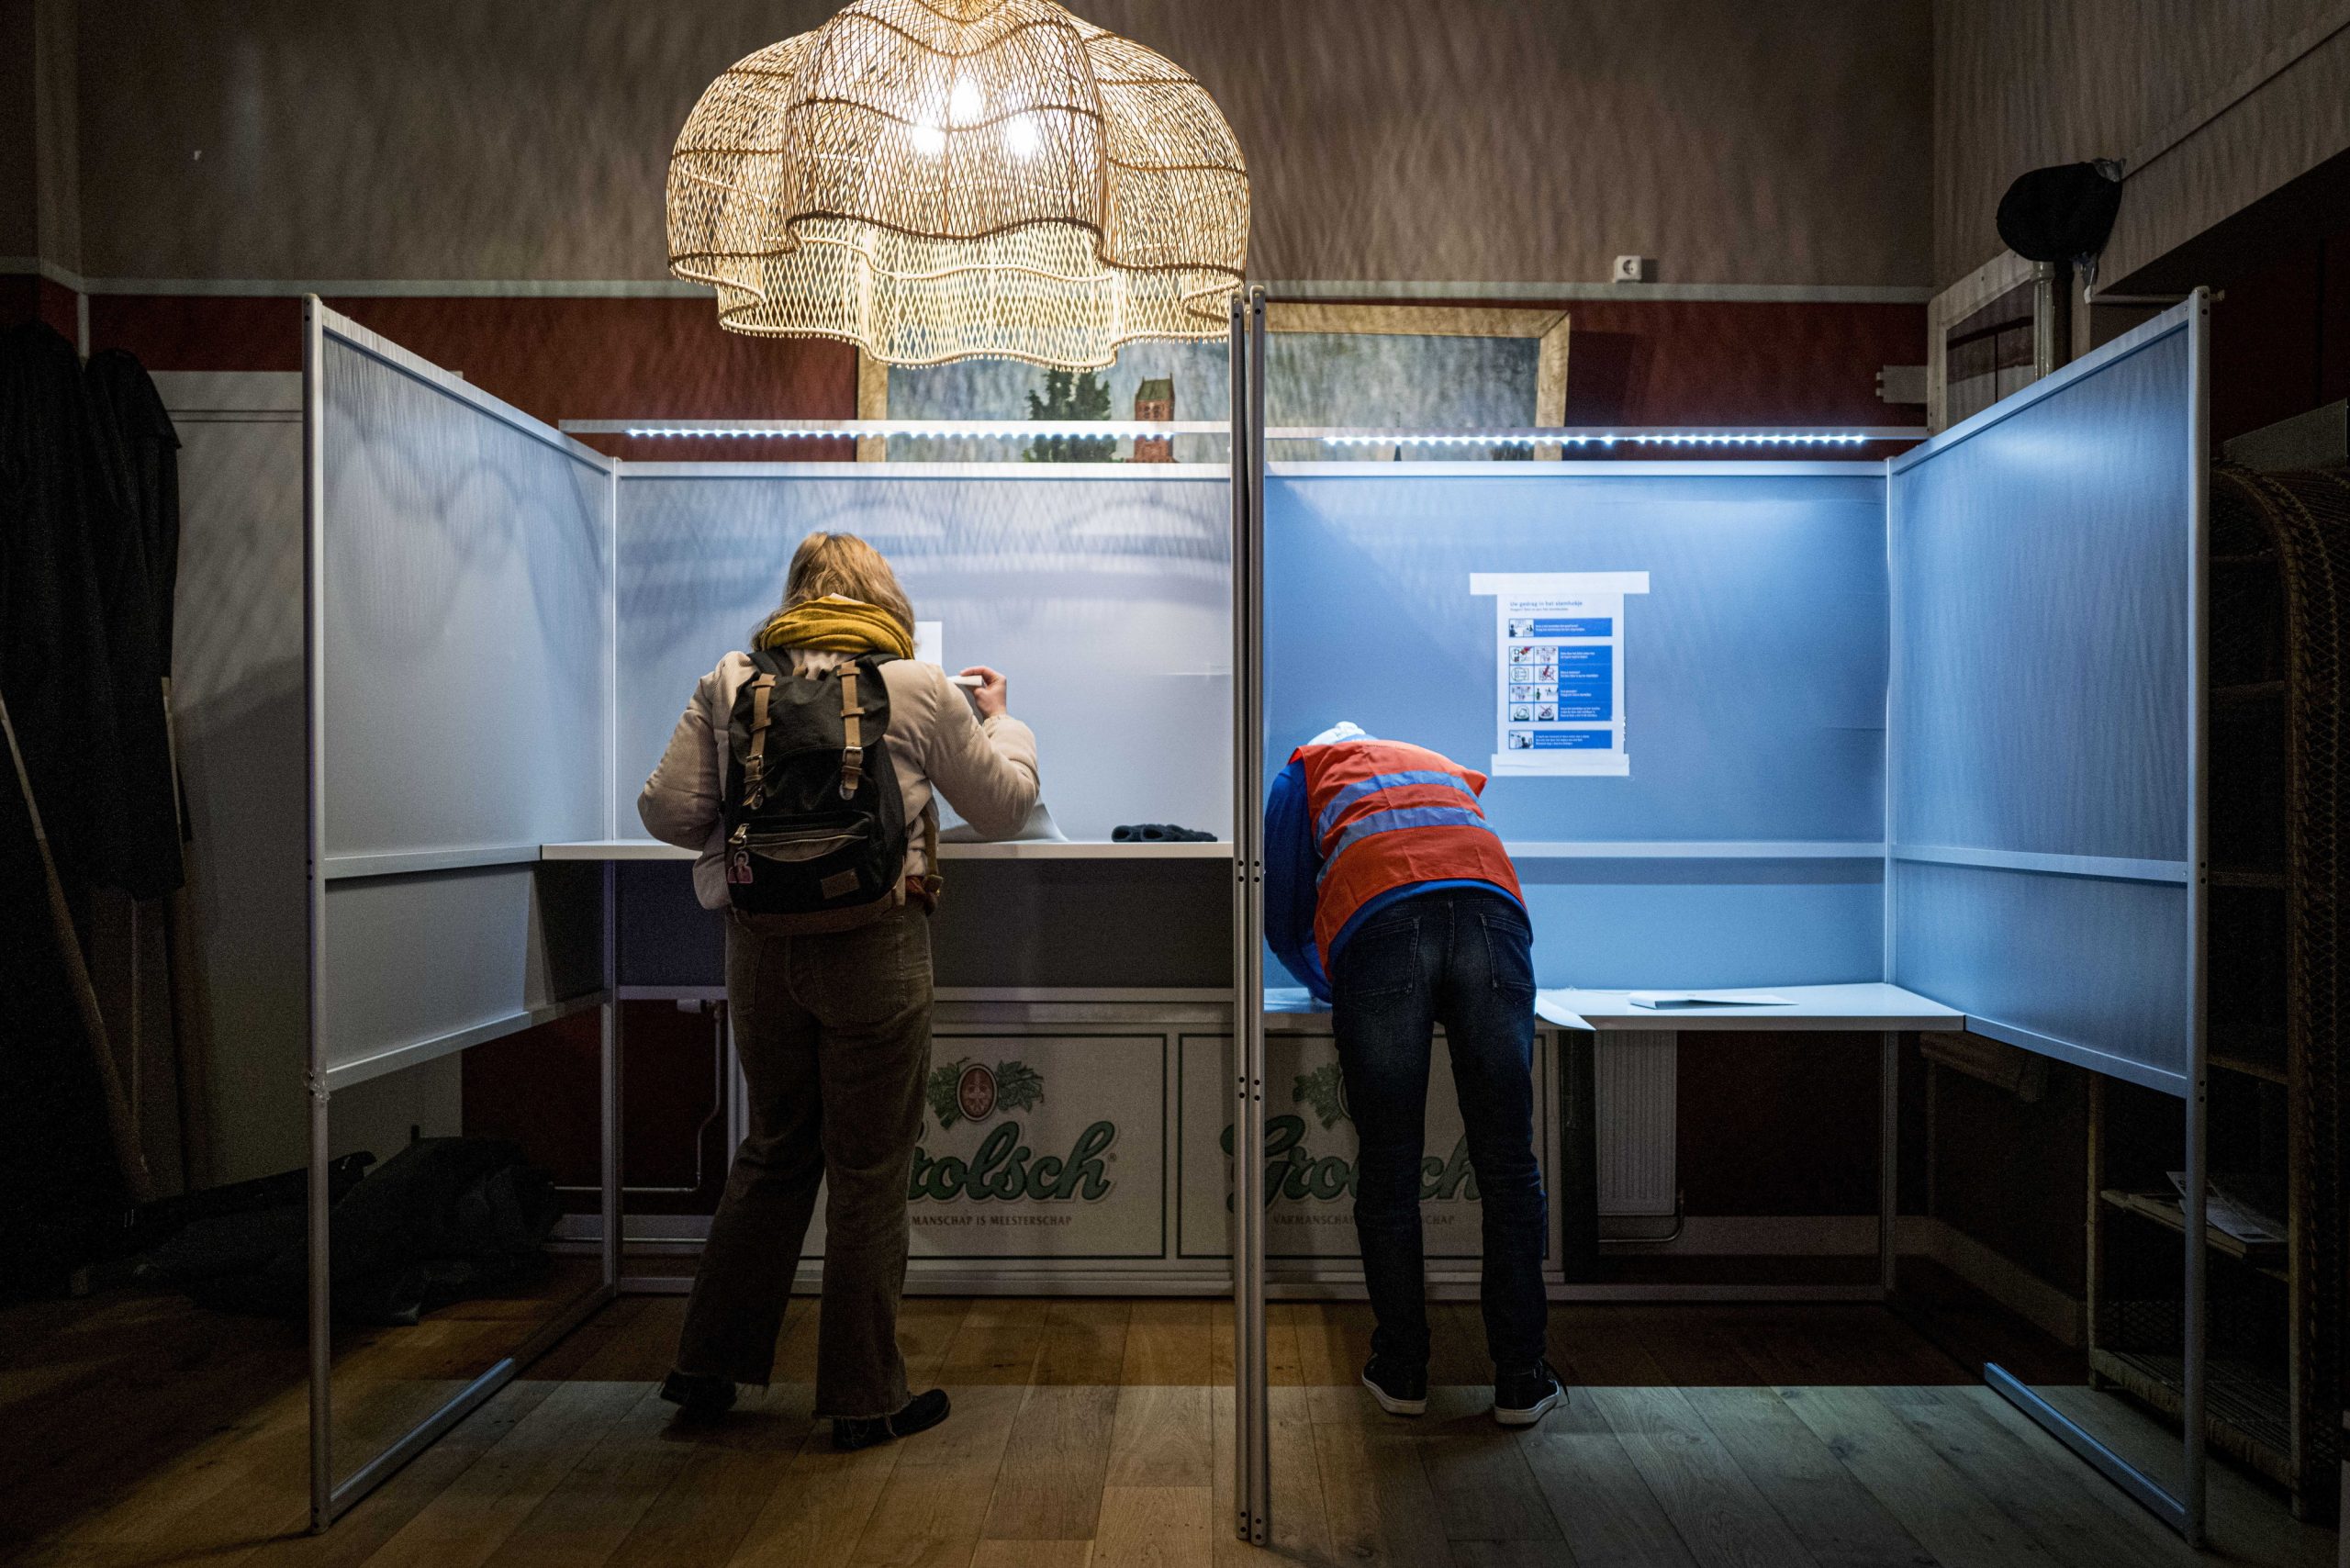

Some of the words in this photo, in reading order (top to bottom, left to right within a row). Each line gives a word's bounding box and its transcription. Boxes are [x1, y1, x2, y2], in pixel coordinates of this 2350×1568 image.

[908, 1120, 1115, 1201] rolsch
[1220, 1114, 1483, 1214] Groch
[910, 1215, 973, 1226] MANSCHAP
[976, 1215, 986, 1226] IS
[990, 1215, 1072, 1226] MEESTERSCHAP
